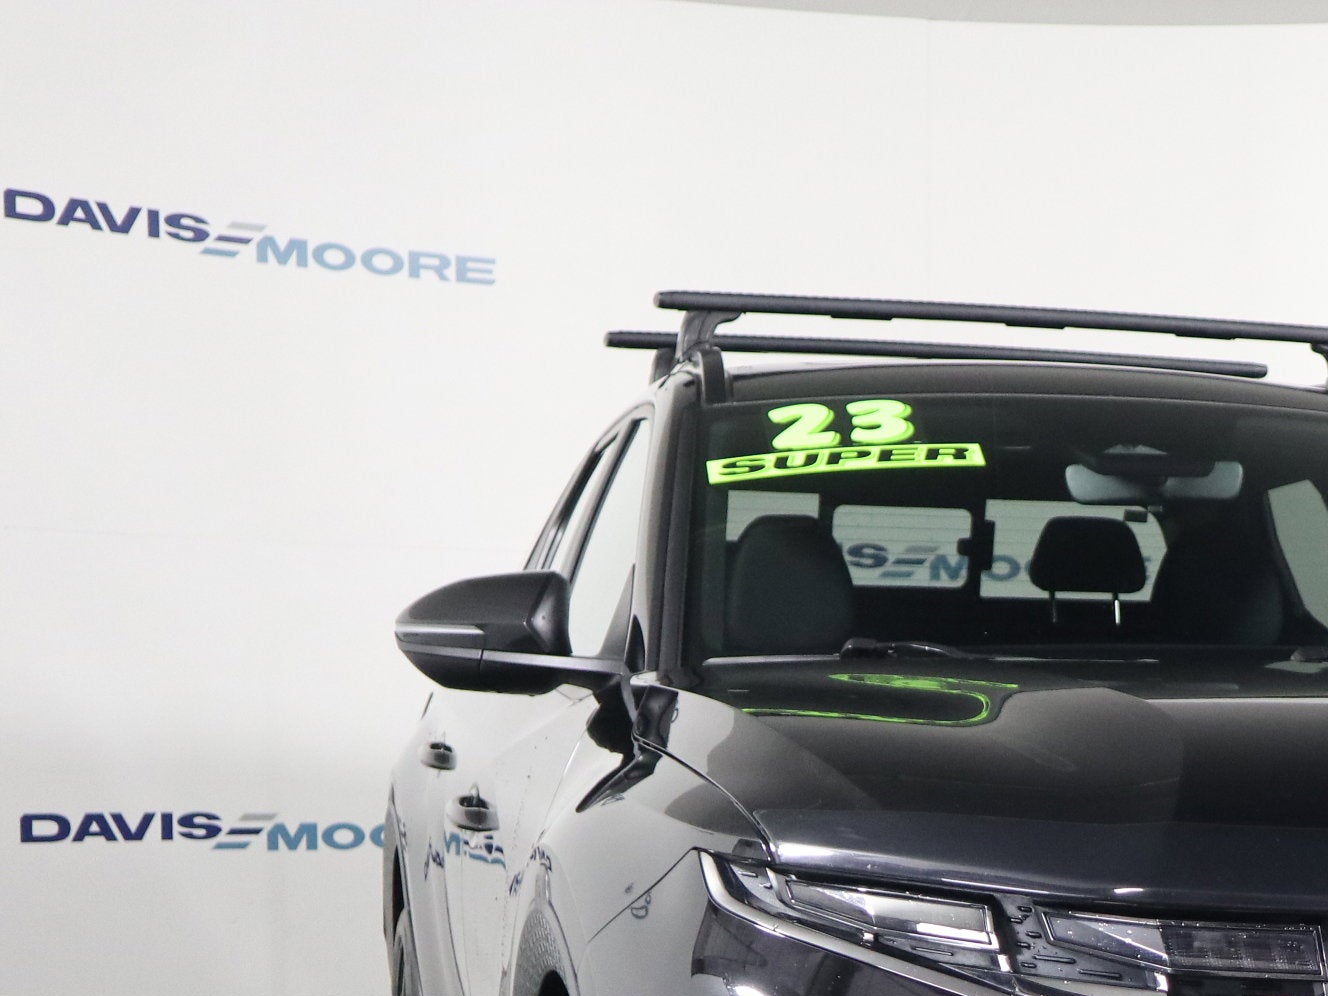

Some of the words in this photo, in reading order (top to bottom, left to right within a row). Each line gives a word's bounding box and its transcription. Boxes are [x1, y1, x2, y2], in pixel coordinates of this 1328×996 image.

[4, 188, 211, 243] DAVIS
[256, 235, 496, 285] MOORE
[767, 399, 915, 450] 23
[718, 446, 971, 477] SUPER
[20, 811, 221, 842] DAVIS
